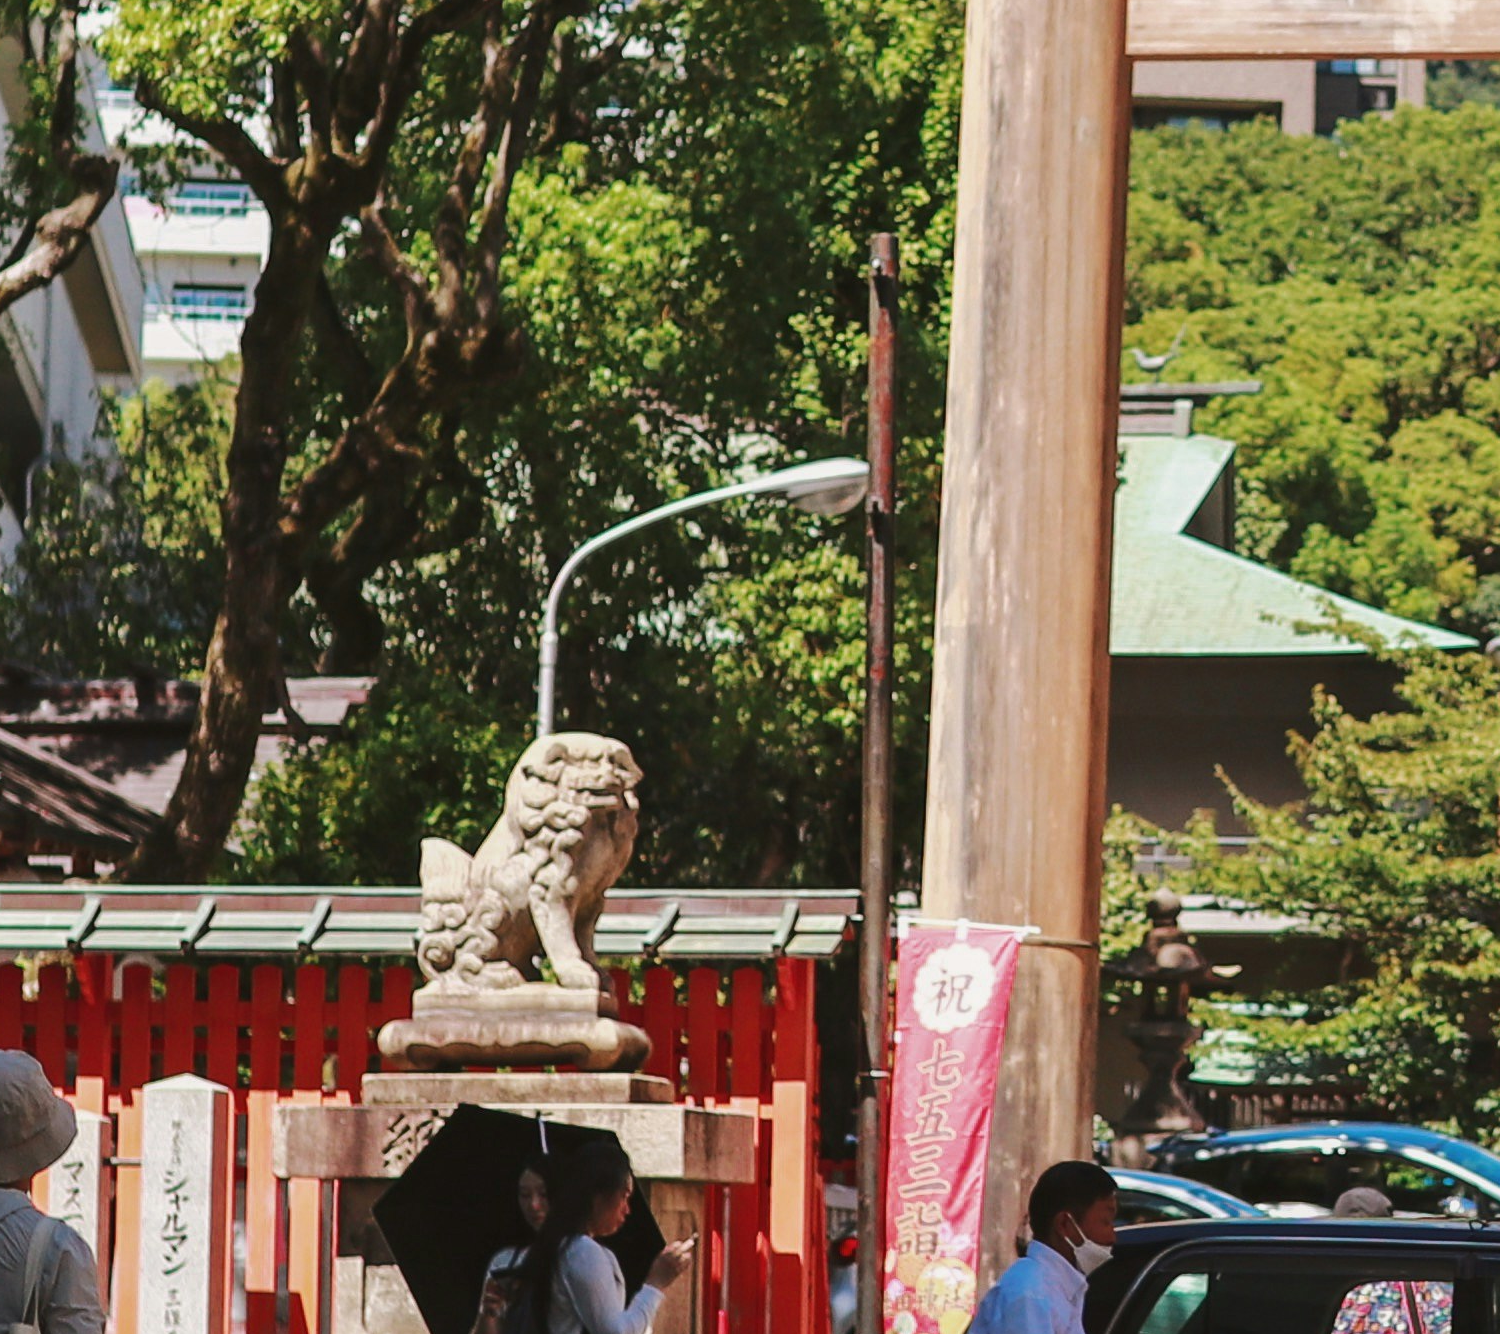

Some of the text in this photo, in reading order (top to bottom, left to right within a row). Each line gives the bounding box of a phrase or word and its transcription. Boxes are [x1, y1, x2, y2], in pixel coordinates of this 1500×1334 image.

[930, 968, 975, 1018] 祝
[896, 1037, 966, 1258] 七五三詣
